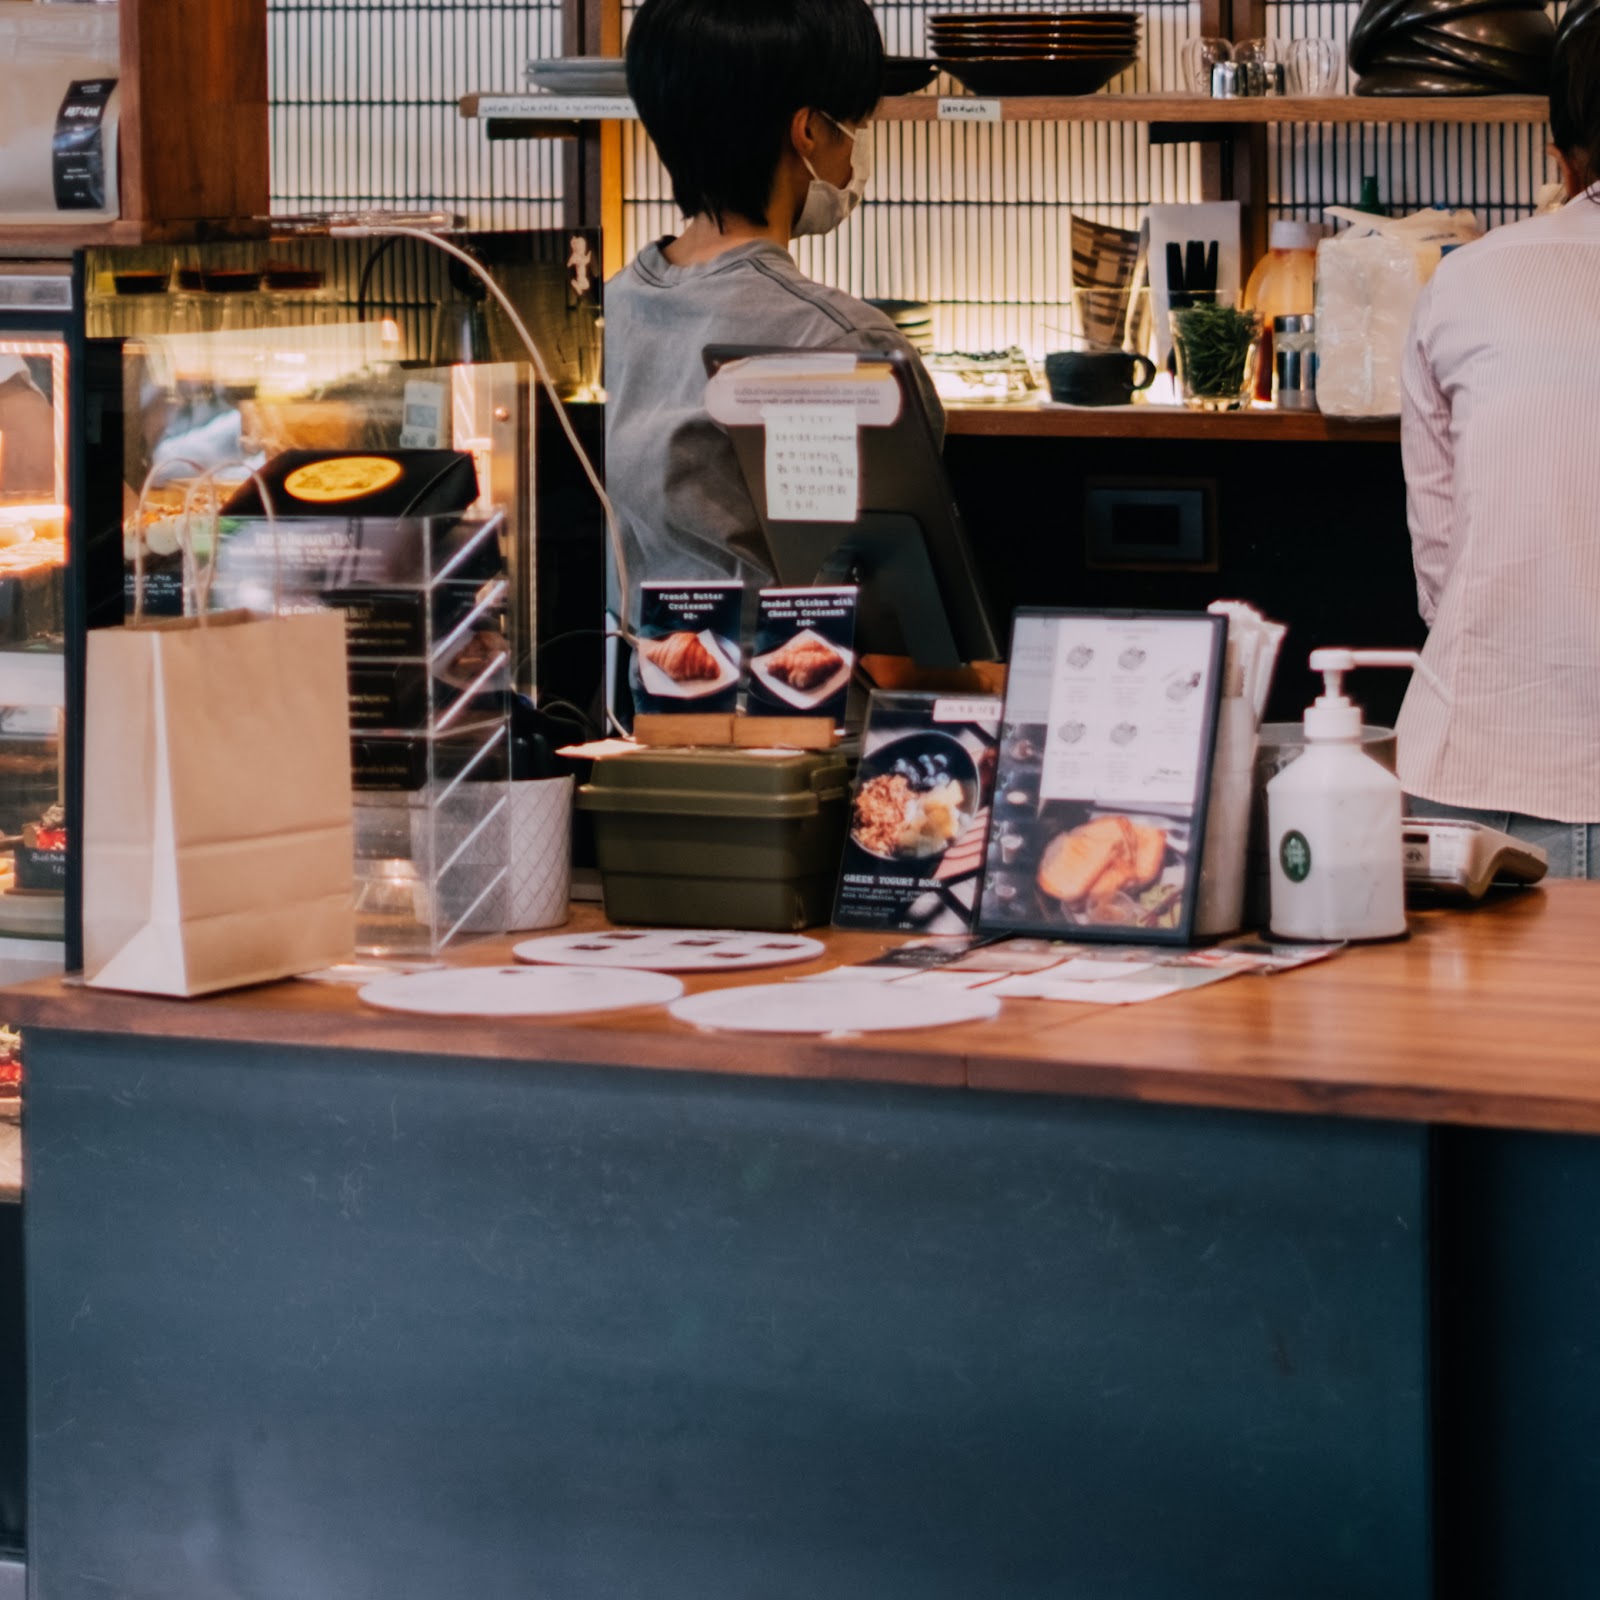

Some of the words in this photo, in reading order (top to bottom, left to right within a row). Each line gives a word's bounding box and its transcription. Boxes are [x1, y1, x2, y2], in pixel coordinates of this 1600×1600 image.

[659, 593, 690, 601] French
[693, 593, 723, 601] Butter
[668, 602, 713, 610] Croissant
[794, 599, 830, 608] Chicken
[832, 598, 854, 607] with
[801, 608, 846, 617] Croissant
[843, 873, 874, 885] GREEK
[879, 876, 914, 887] YOGURT
[918, 878, 942, 889] BOWL
